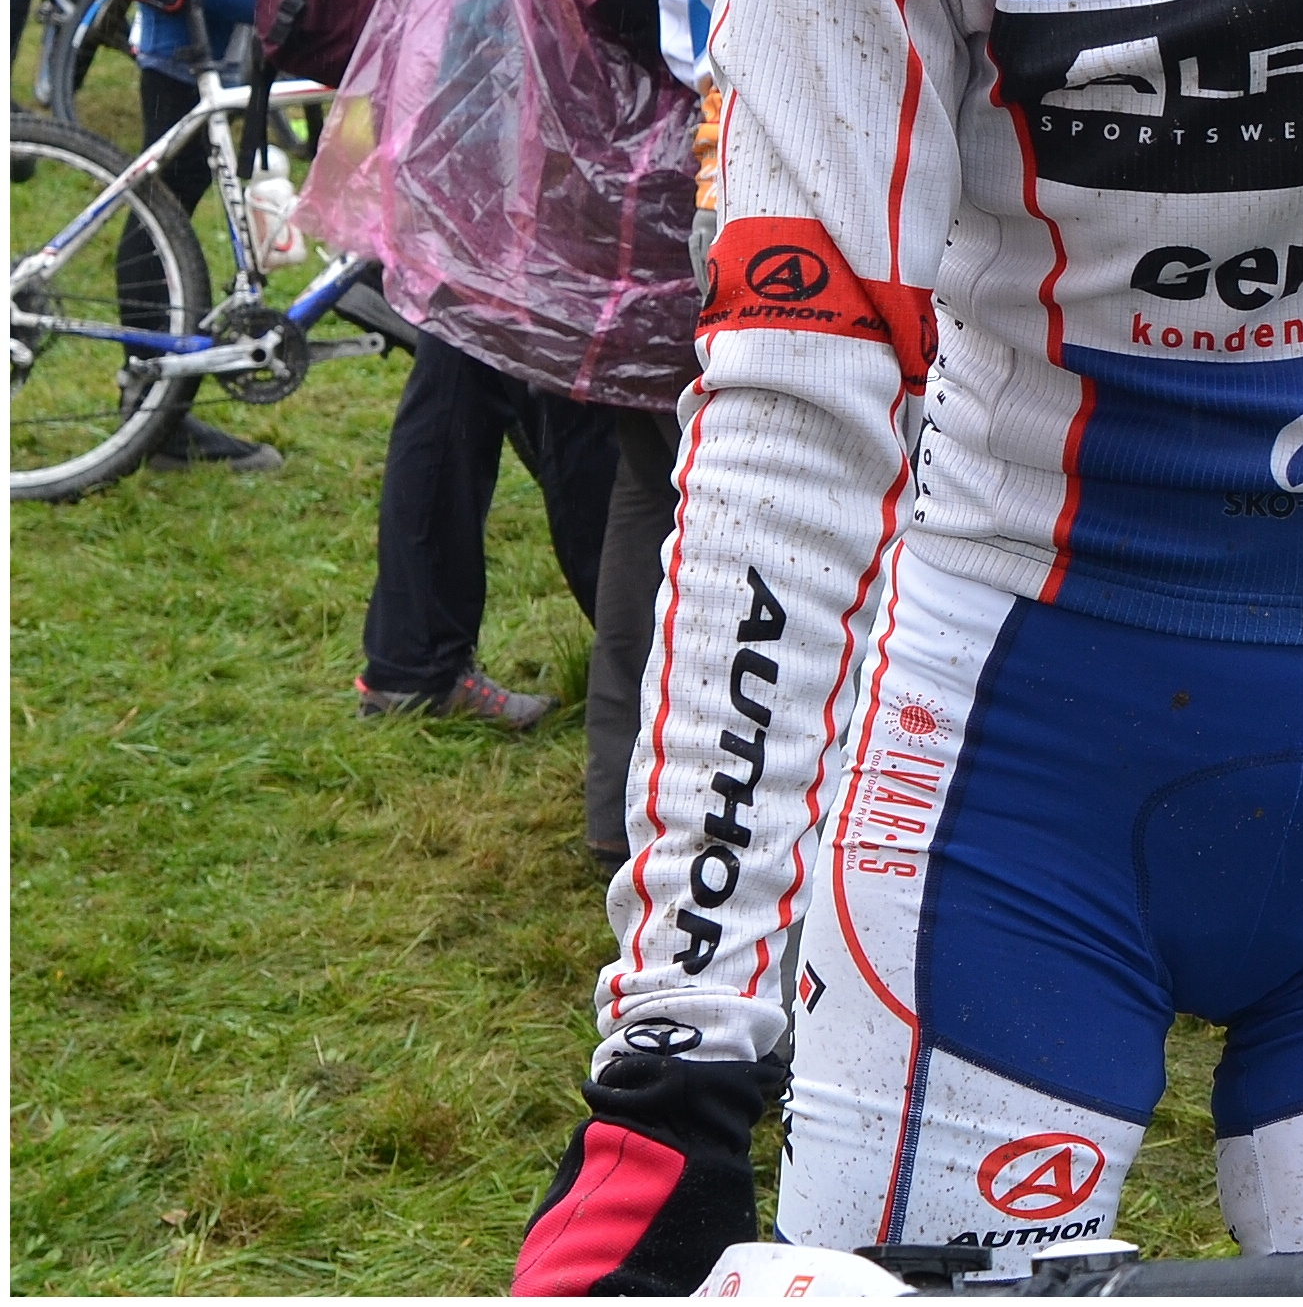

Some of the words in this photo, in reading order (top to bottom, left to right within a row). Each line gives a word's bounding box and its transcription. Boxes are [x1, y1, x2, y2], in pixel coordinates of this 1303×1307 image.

[737, 305, 834, 323] AUTHOR
[672, 565, 787, 976] AUTHOR
[945, 1216, 1101, 1249] AUTHOR
